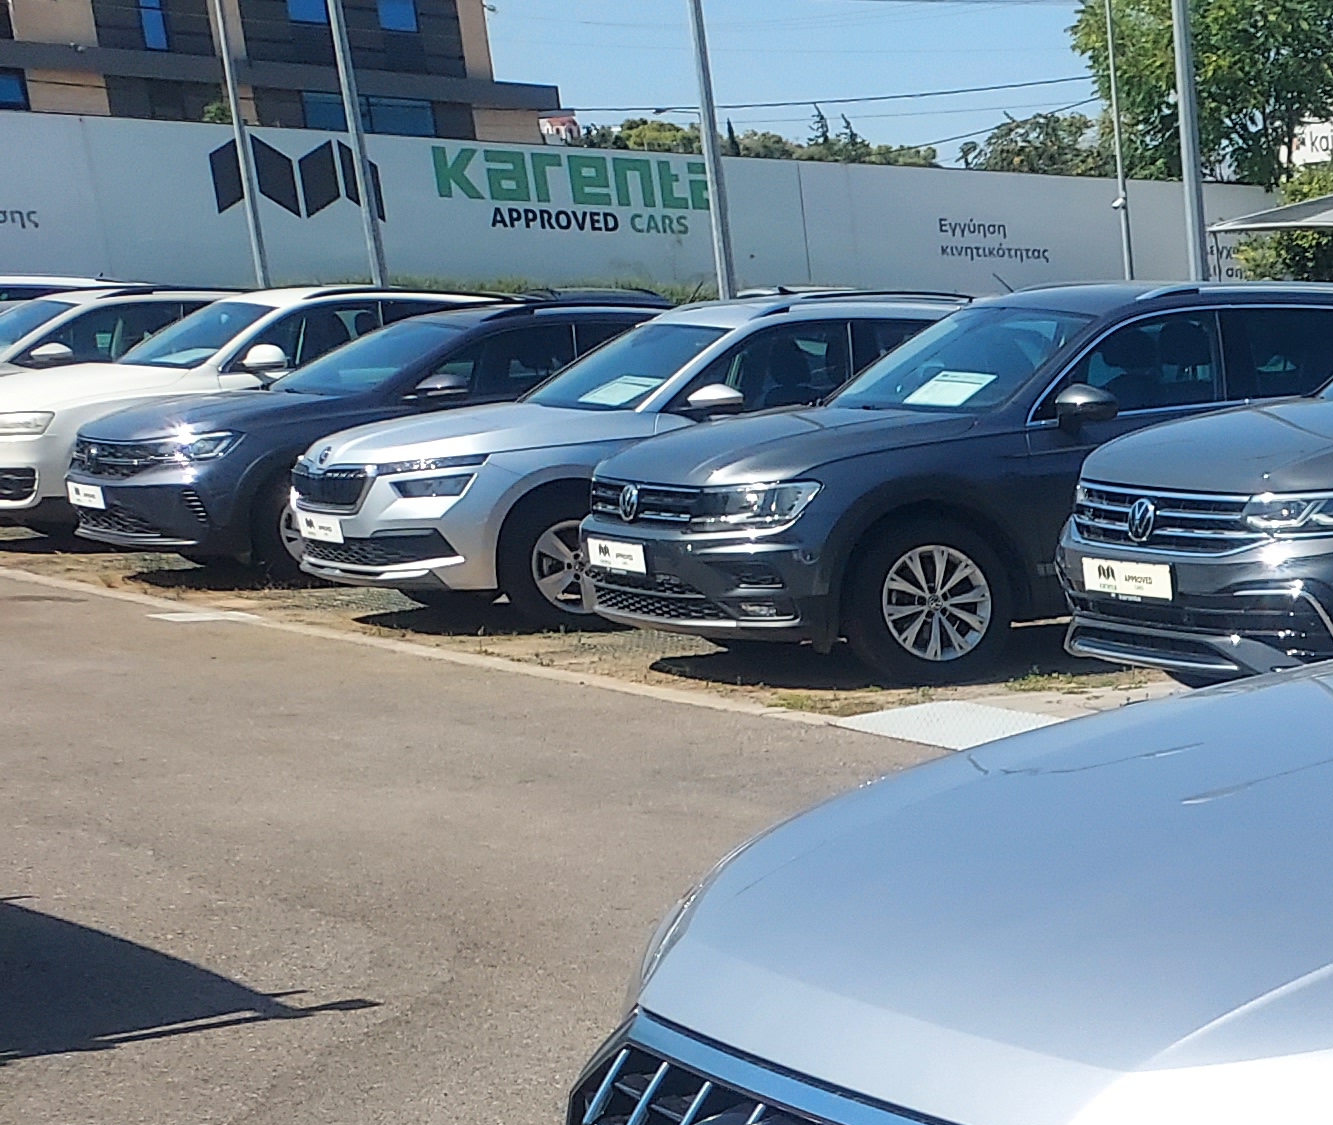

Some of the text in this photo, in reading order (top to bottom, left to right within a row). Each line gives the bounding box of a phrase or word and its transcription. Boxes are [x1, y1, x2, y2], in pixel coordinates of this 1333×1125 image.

[490, 206, 690, 236] APPROVED CARS
[938, 217, 1008, 240] Εγγύηση
[940, 242, 1050, 264] κινητικότητας
